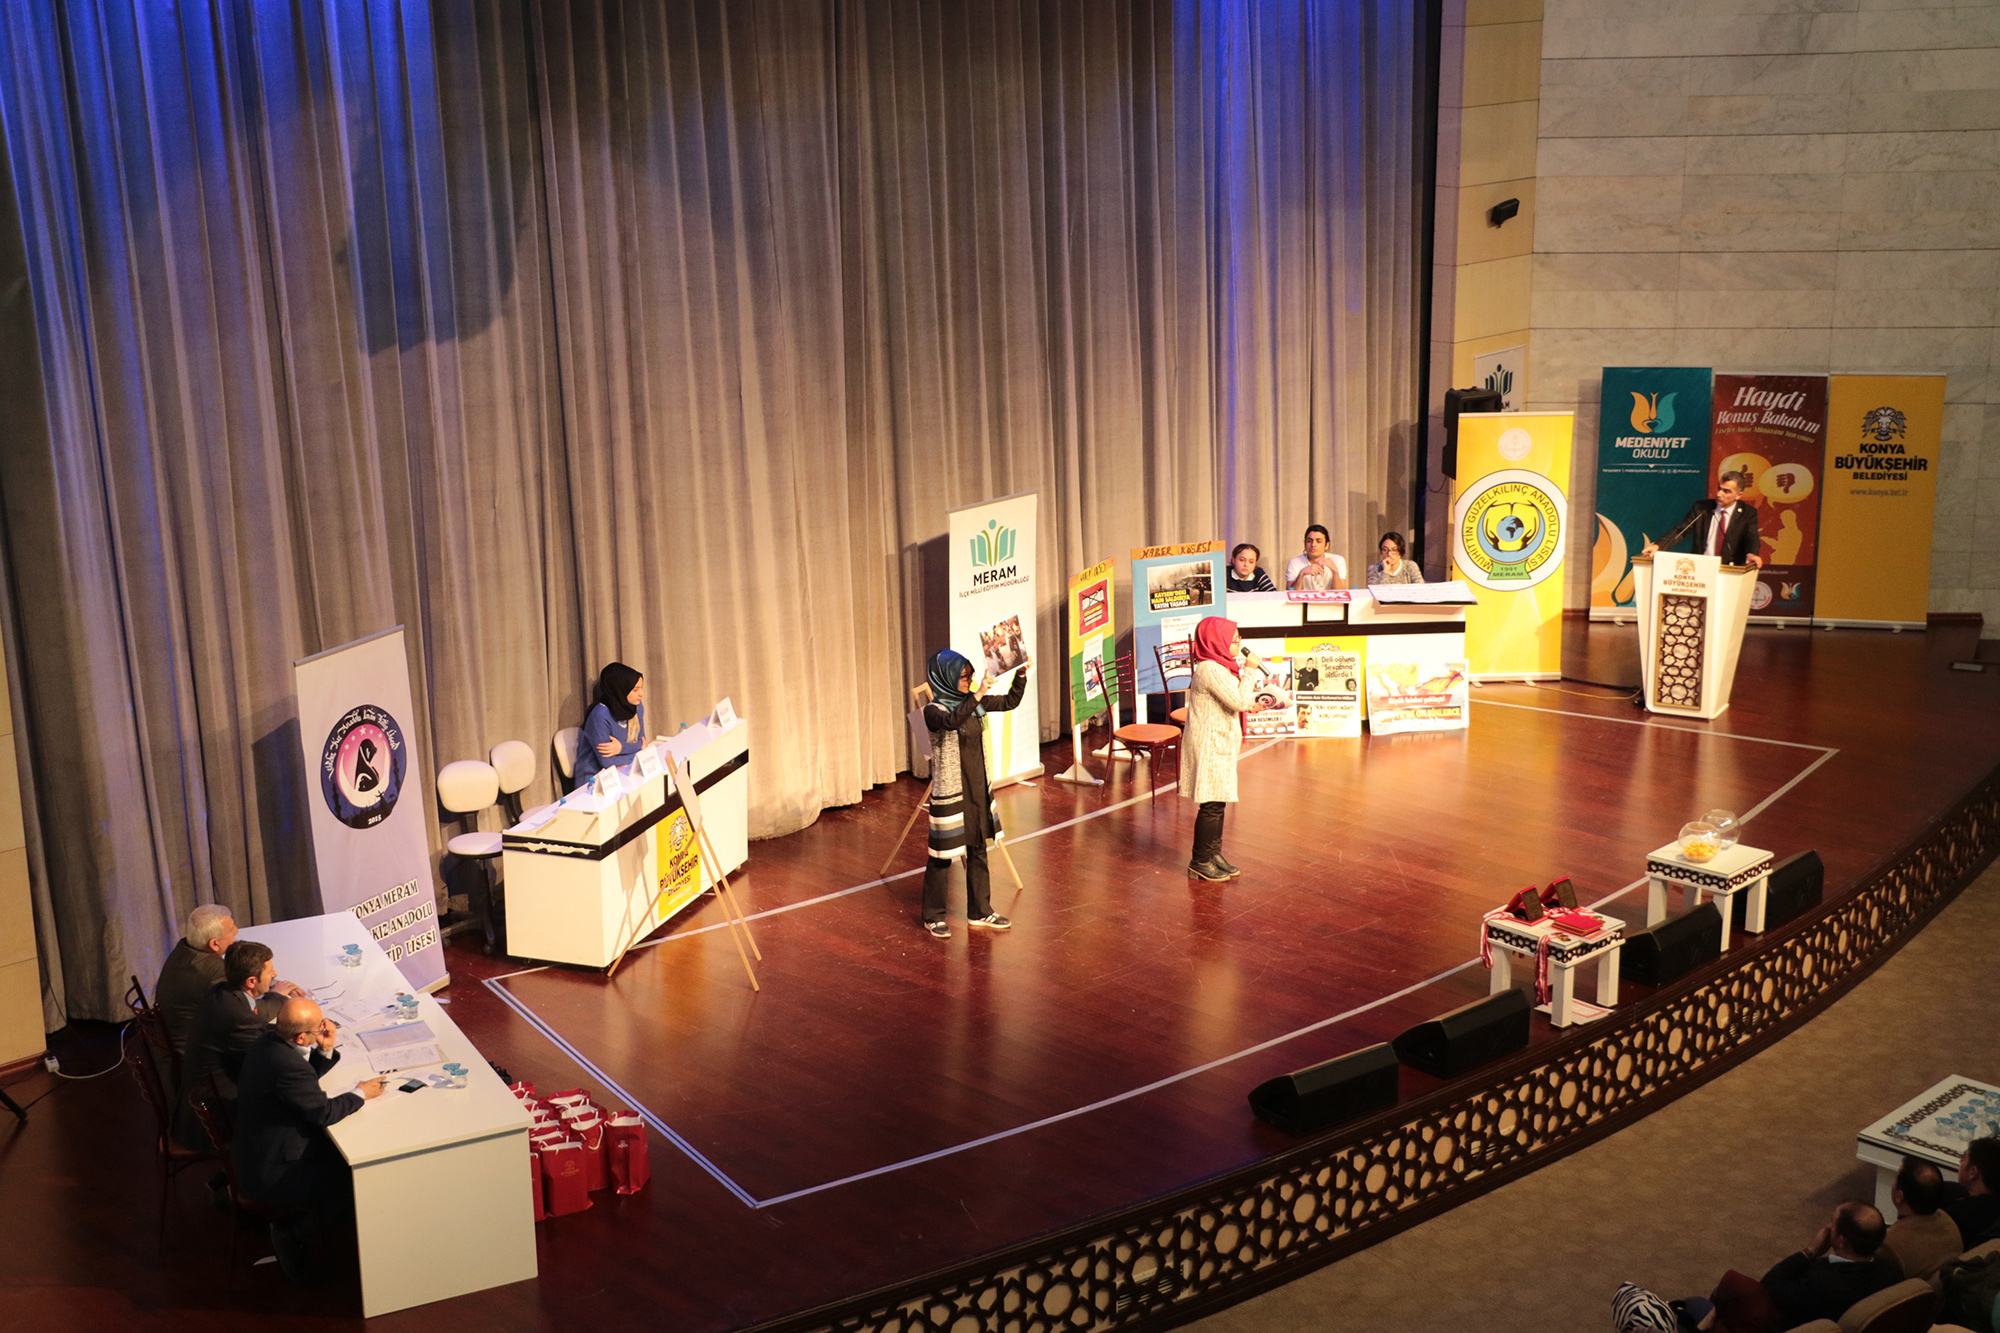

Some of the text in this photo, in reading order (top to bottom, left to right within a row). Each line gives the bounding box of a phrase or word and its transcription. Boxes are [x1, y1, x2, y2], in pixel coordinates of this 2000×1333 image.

[1733, 386, 1807, 411] Haydi
[1716, 411, 1820, 434] Konuş Bakalım
[1632, 448, 1670, 458] OKULU
[1859, 443, 1905, 454] KONYA
[1835, 454, 1928, 472] BÜYÜKŞEHİR
[1853, 471, 1908, 480] BELEDİYESİ
[1531, 490, 1557, 537] ANADOLU
[1140, 546, 1173, 559] HABER
[973, 565, 1016, 586] MERAM
[1663, 579, 1706, 589] BÜYÜKŞEHİR
[1290, 591, 1349, 600] RTÜK
[368, 814, 382, 824] 2015
[350, 880, 419, 919] ONYA MERAM
[371, 902, 433, 940] KIZ ANADOLU
[405, 925, 437, 955] LİSESİ
